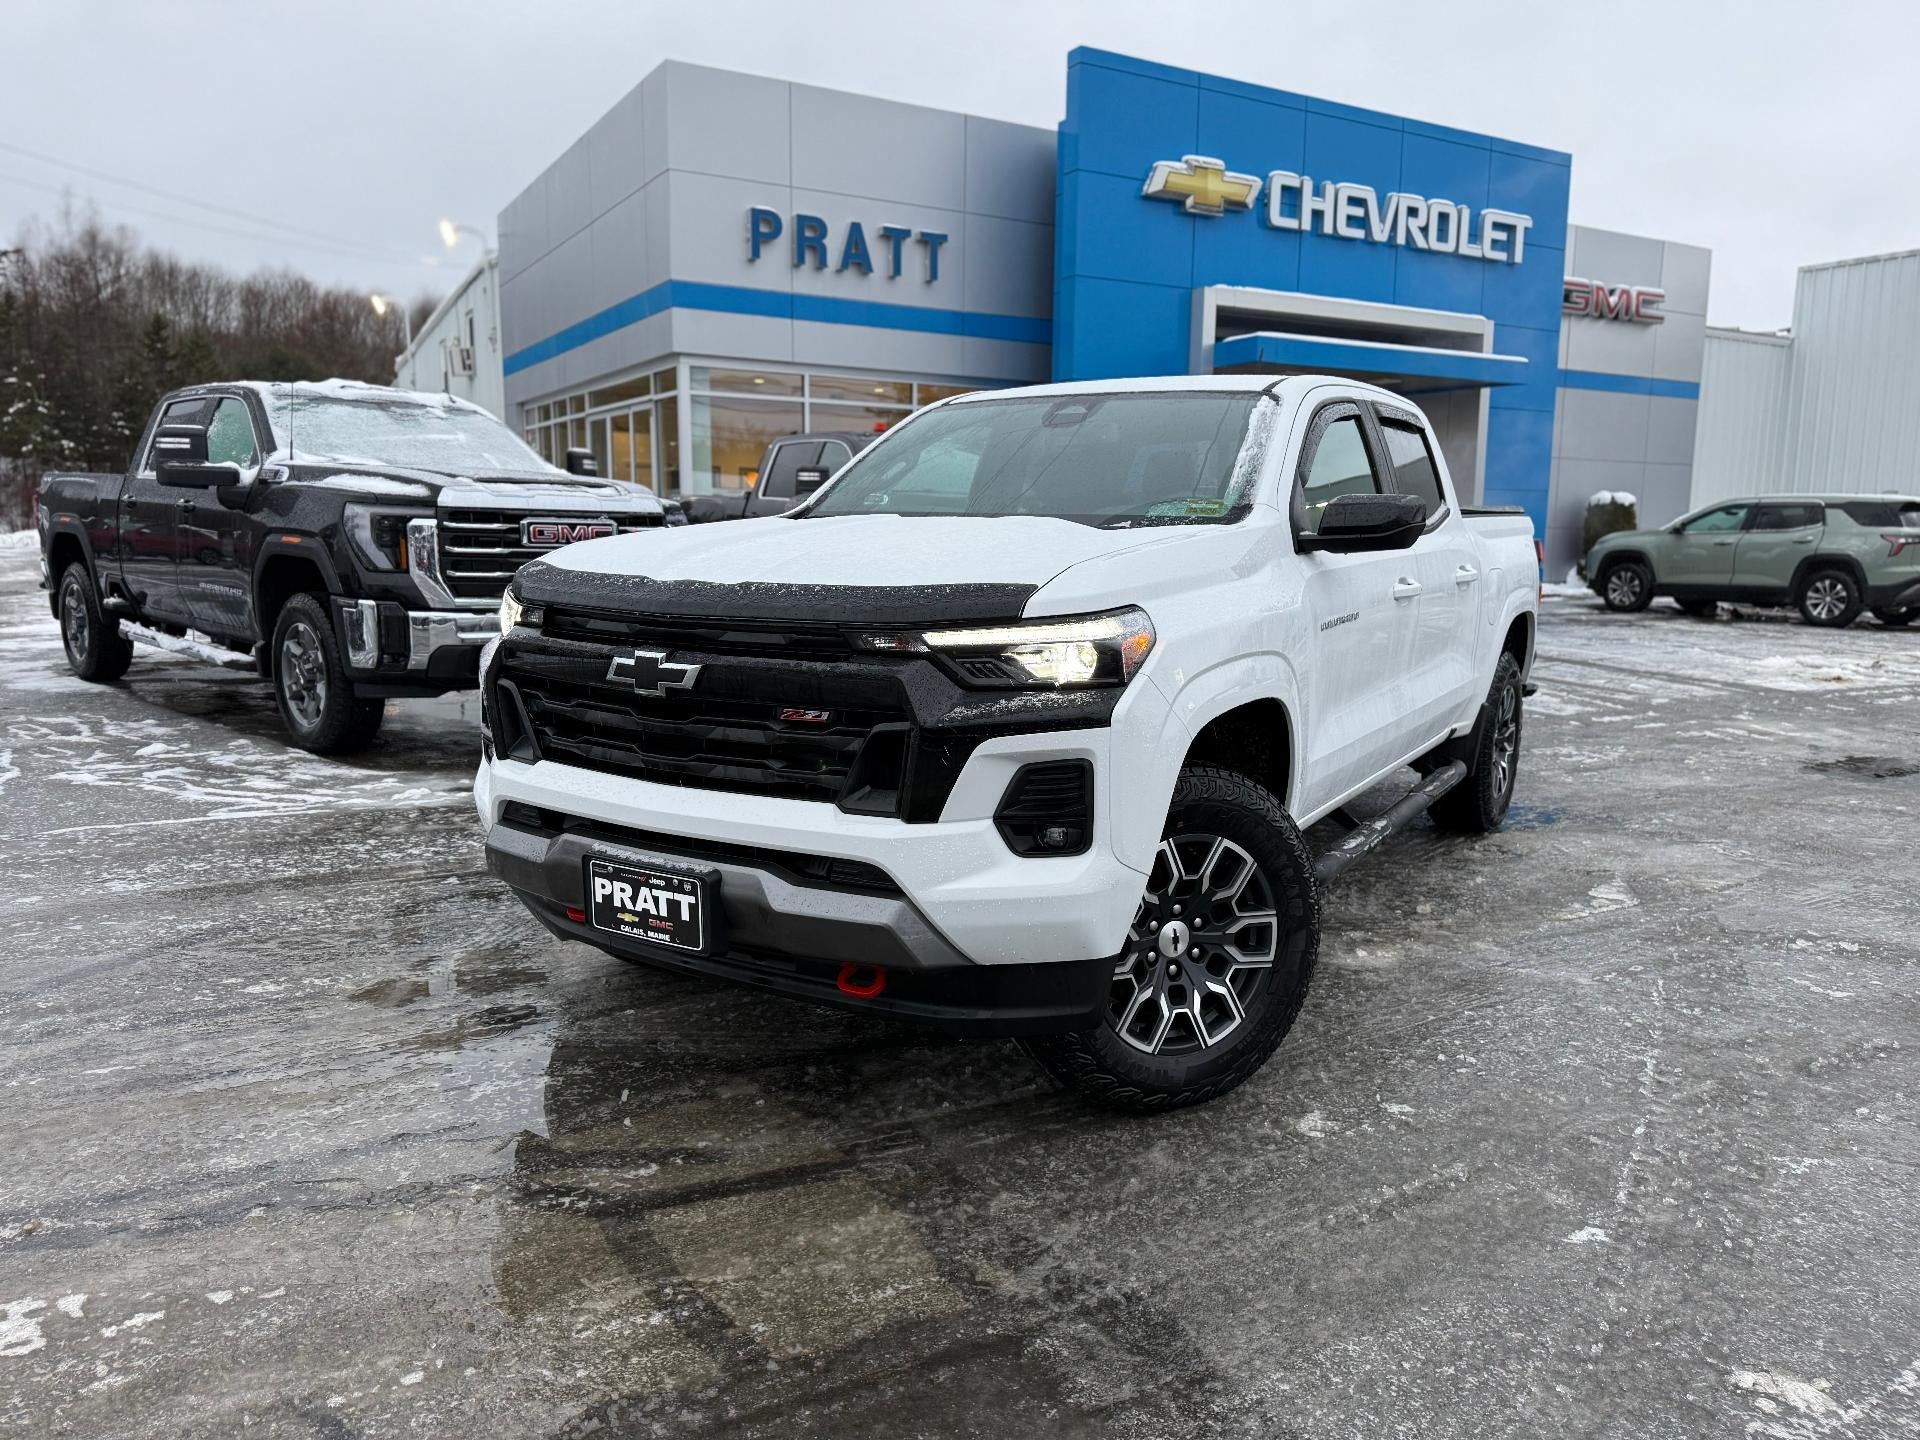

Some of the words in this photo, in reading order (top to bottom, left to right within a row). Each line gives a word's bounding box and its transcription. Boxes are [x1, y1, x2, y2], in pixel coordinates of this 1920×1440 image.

[1267, 170, 1533, 265] CHEVROLET
[747, 205, 949, 284] PRATT
[1563, 276, 1665, 325] GMC
[594, 876, 696, 922] PRATT
[648, 876, 666, 887] Jeep
[647, 930, 671, 942] MAINE
[648, 918, 674, 931] GMC
